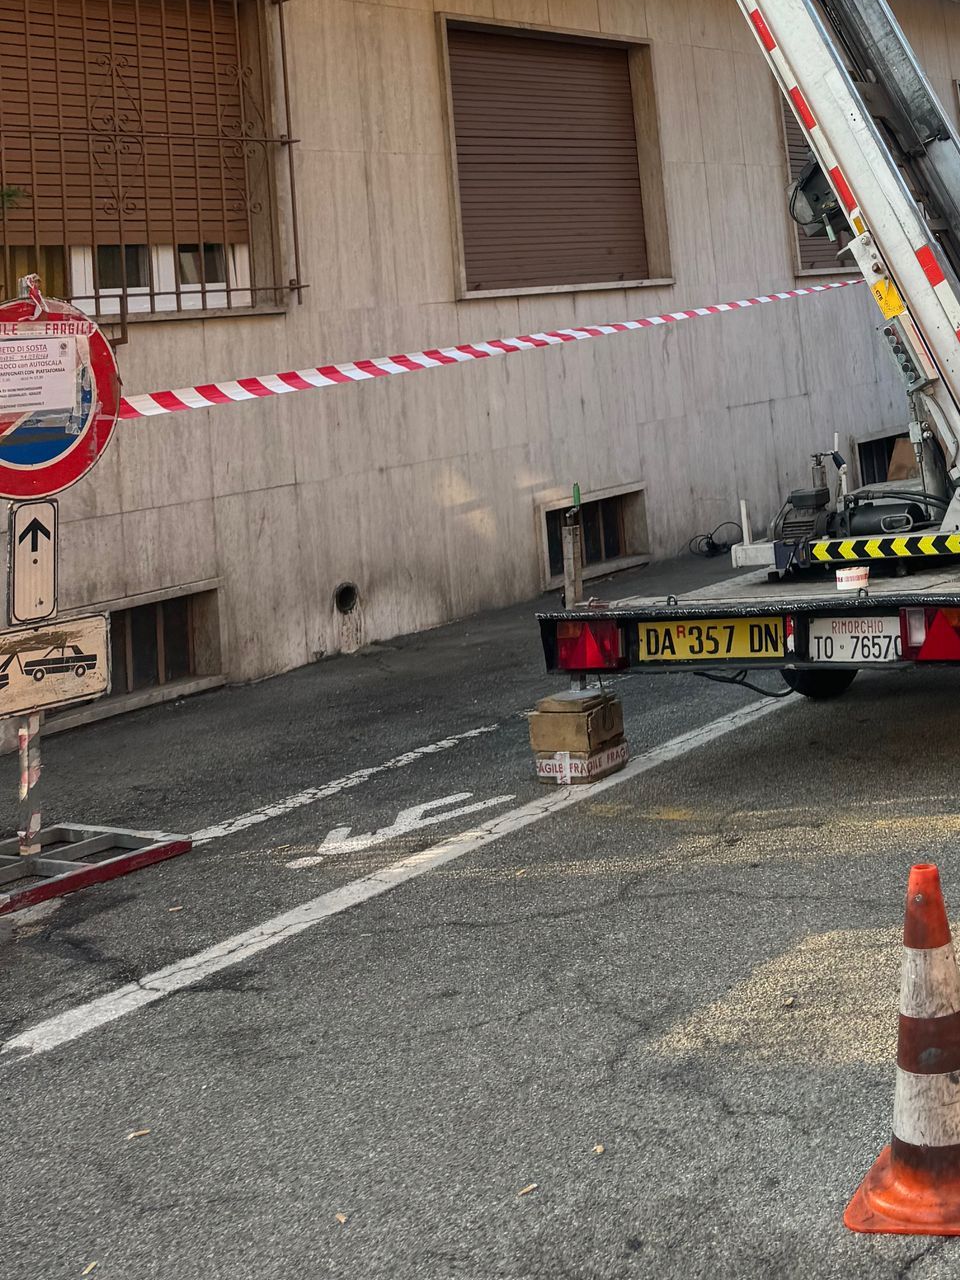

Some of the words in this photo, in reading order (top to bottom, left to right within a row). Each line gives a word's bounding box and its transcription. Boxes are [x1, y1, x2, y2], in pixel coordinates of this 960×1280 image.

[26, 344, 48, 352] SOSTA
[29, 359, 62, 368] AUTOSCALA
[831, 620, 884, 634] RIMORCHIO
[646, 627, 677, 656] DA
[688, 625, 735, 654] 357
[750, 623, 779, 653] DN
[813, 635, 834, 660] TO
